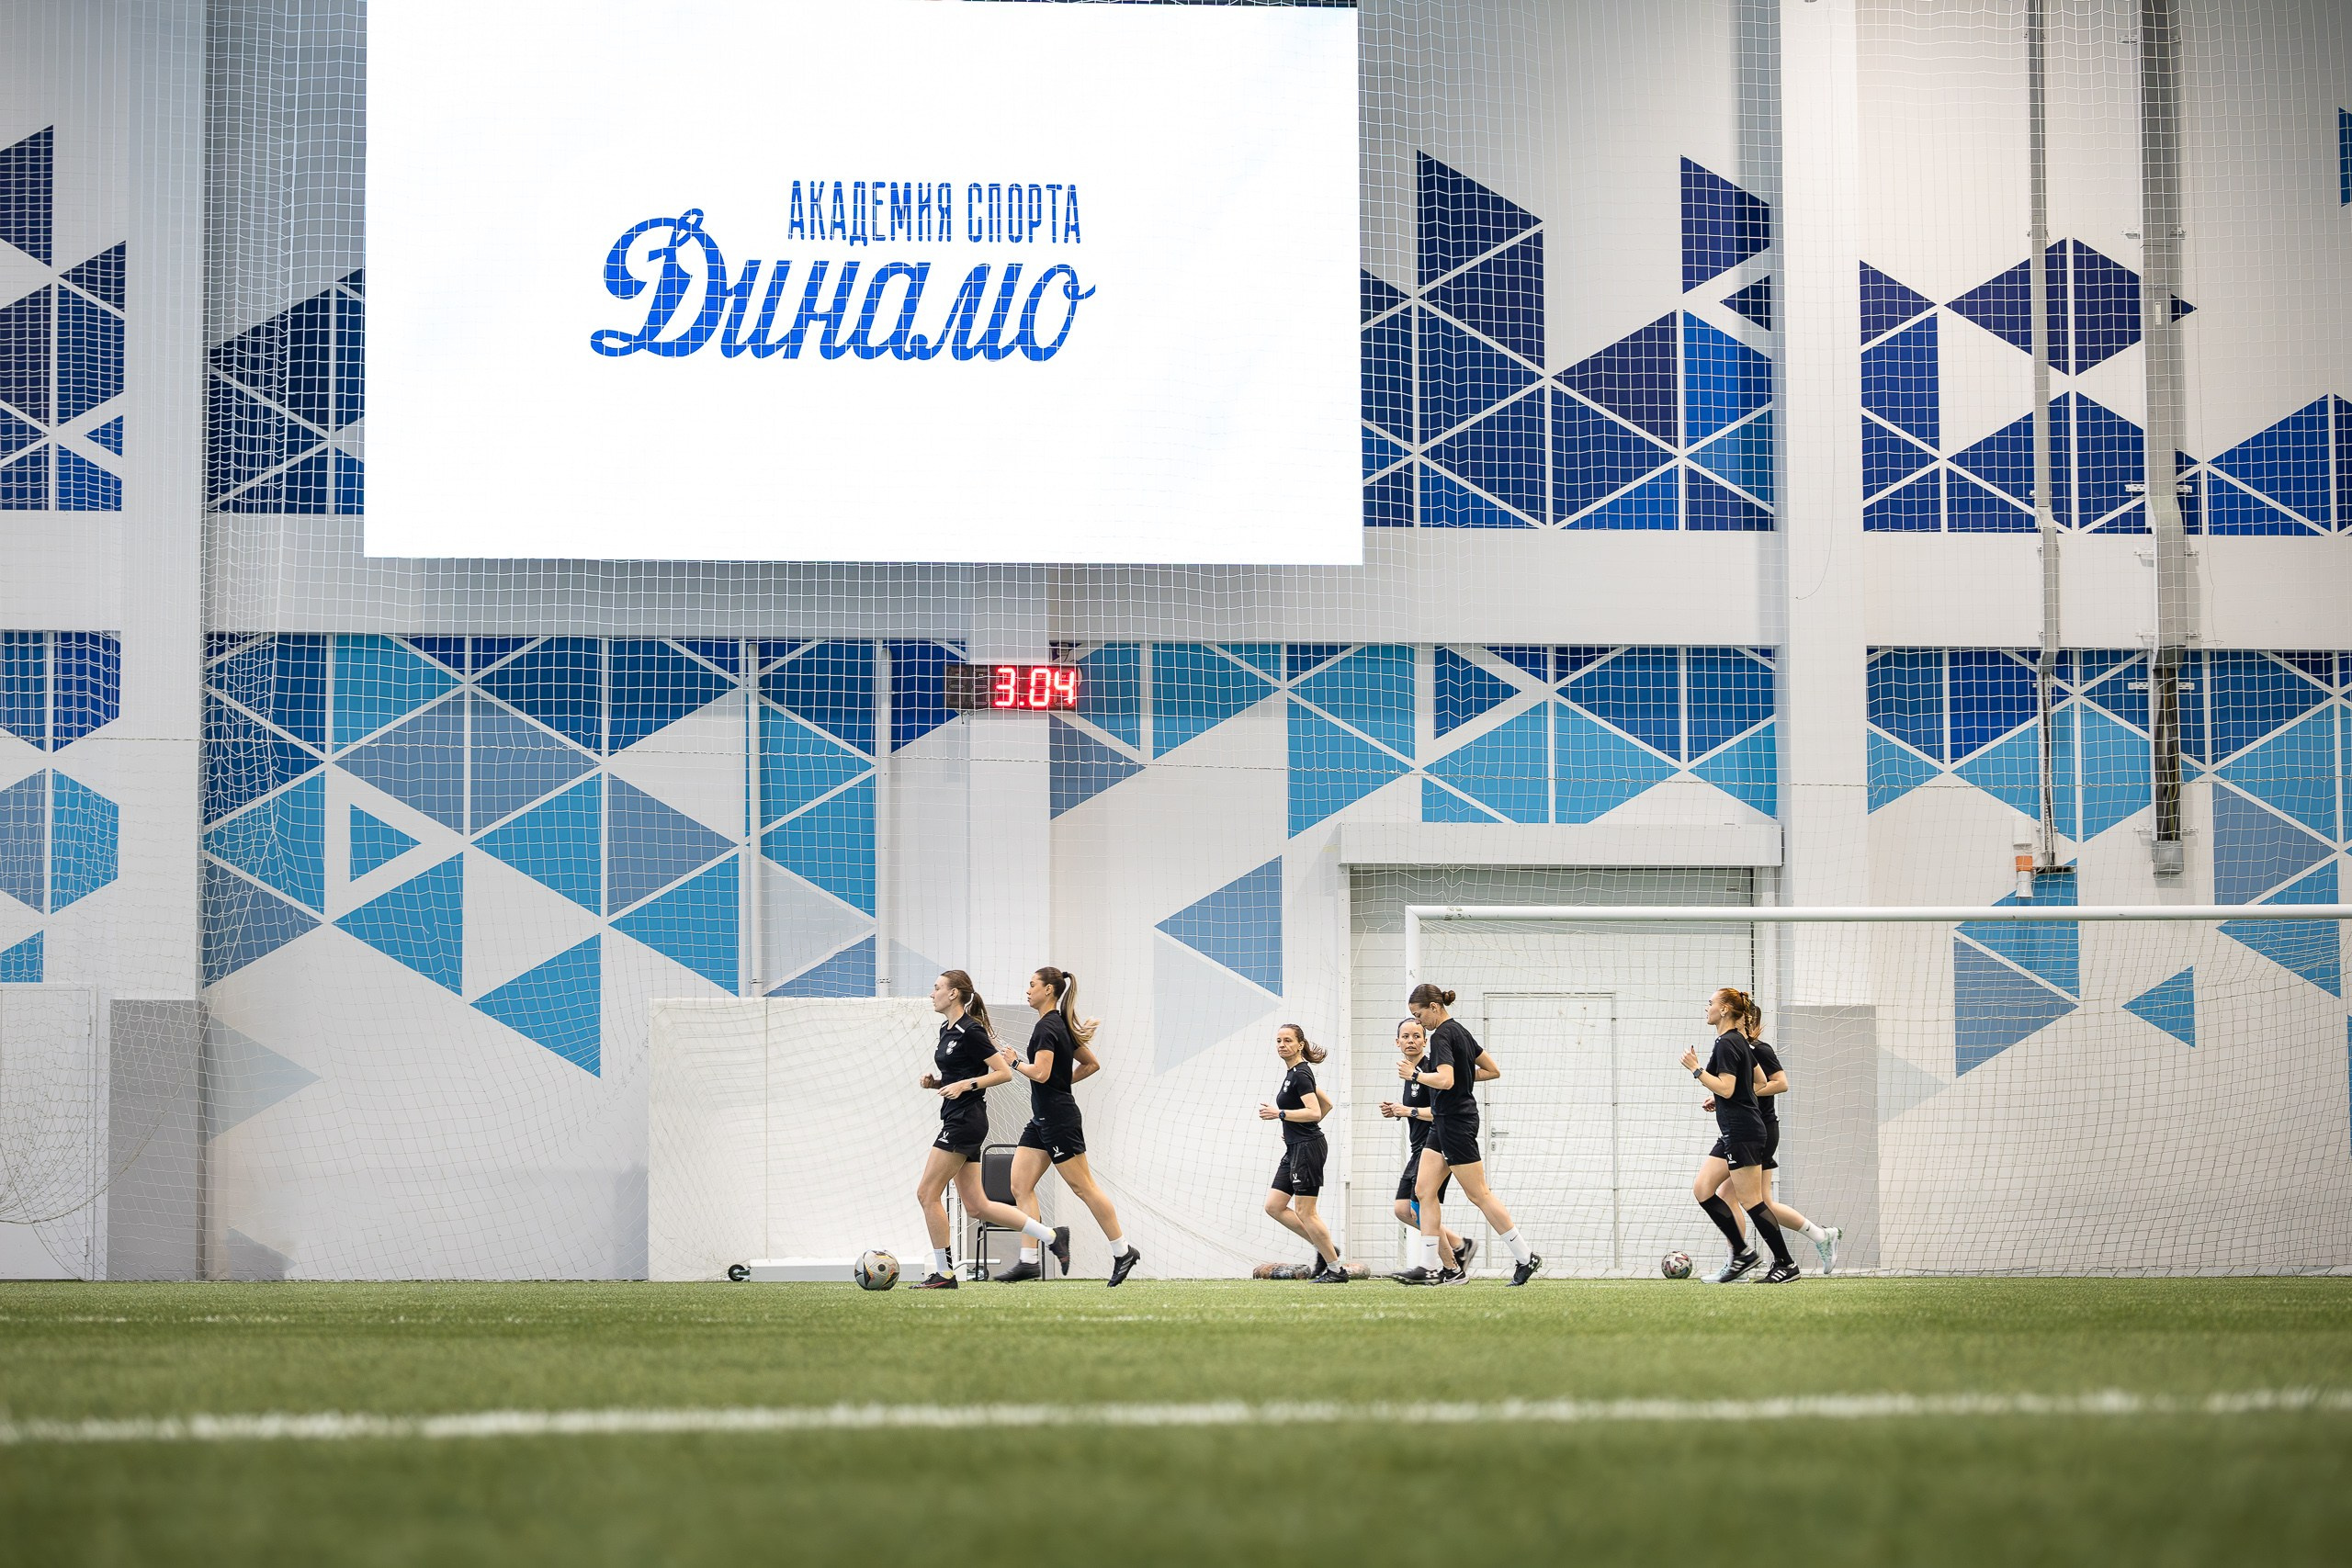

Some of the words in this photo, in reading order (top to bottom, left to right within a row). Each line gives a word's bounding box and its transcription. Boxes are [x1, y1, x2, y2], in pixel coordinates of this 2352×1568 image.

[788, 180, 952, 246] АКАДЕМИЯ
[967, 183, 1081, 244] СПОРТА
[590, 208, 1096, 362] Динамо
[995, 667, 1076, 707] 3.04
